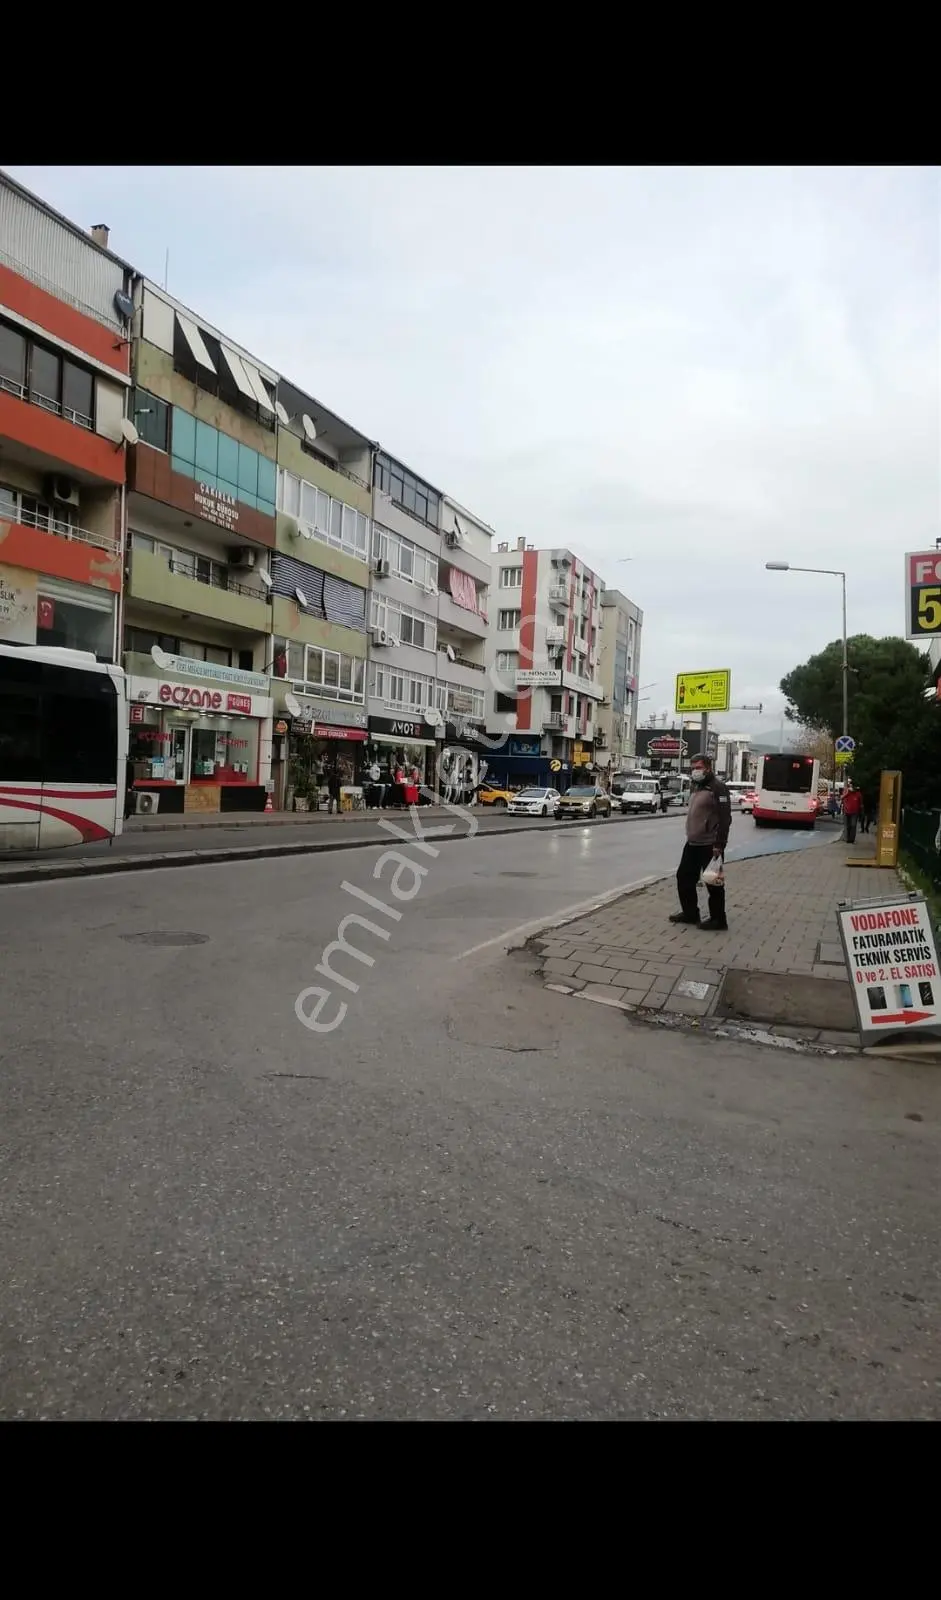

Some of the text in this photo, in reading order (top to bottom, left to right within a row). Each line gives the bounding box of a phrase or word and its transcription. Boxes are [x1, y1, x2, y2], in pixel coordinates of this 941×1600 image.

[195, 493, 214, 508] HUKUK
[160, 684, 223, 709] eczane
[133, 708, 142, 720] E
[851, 908, 919, 931] VODAFONE
[853, 927, 926, 950] FATURAMATİK
[853, 944, 931, 967] TEKNİK SERVİS
[865, 971, 877, 983] ve
[878, 968, 888, 981] 2.
[890, 966, 903, 980] EL
[904, 963, 936, 979] SATIŞI
